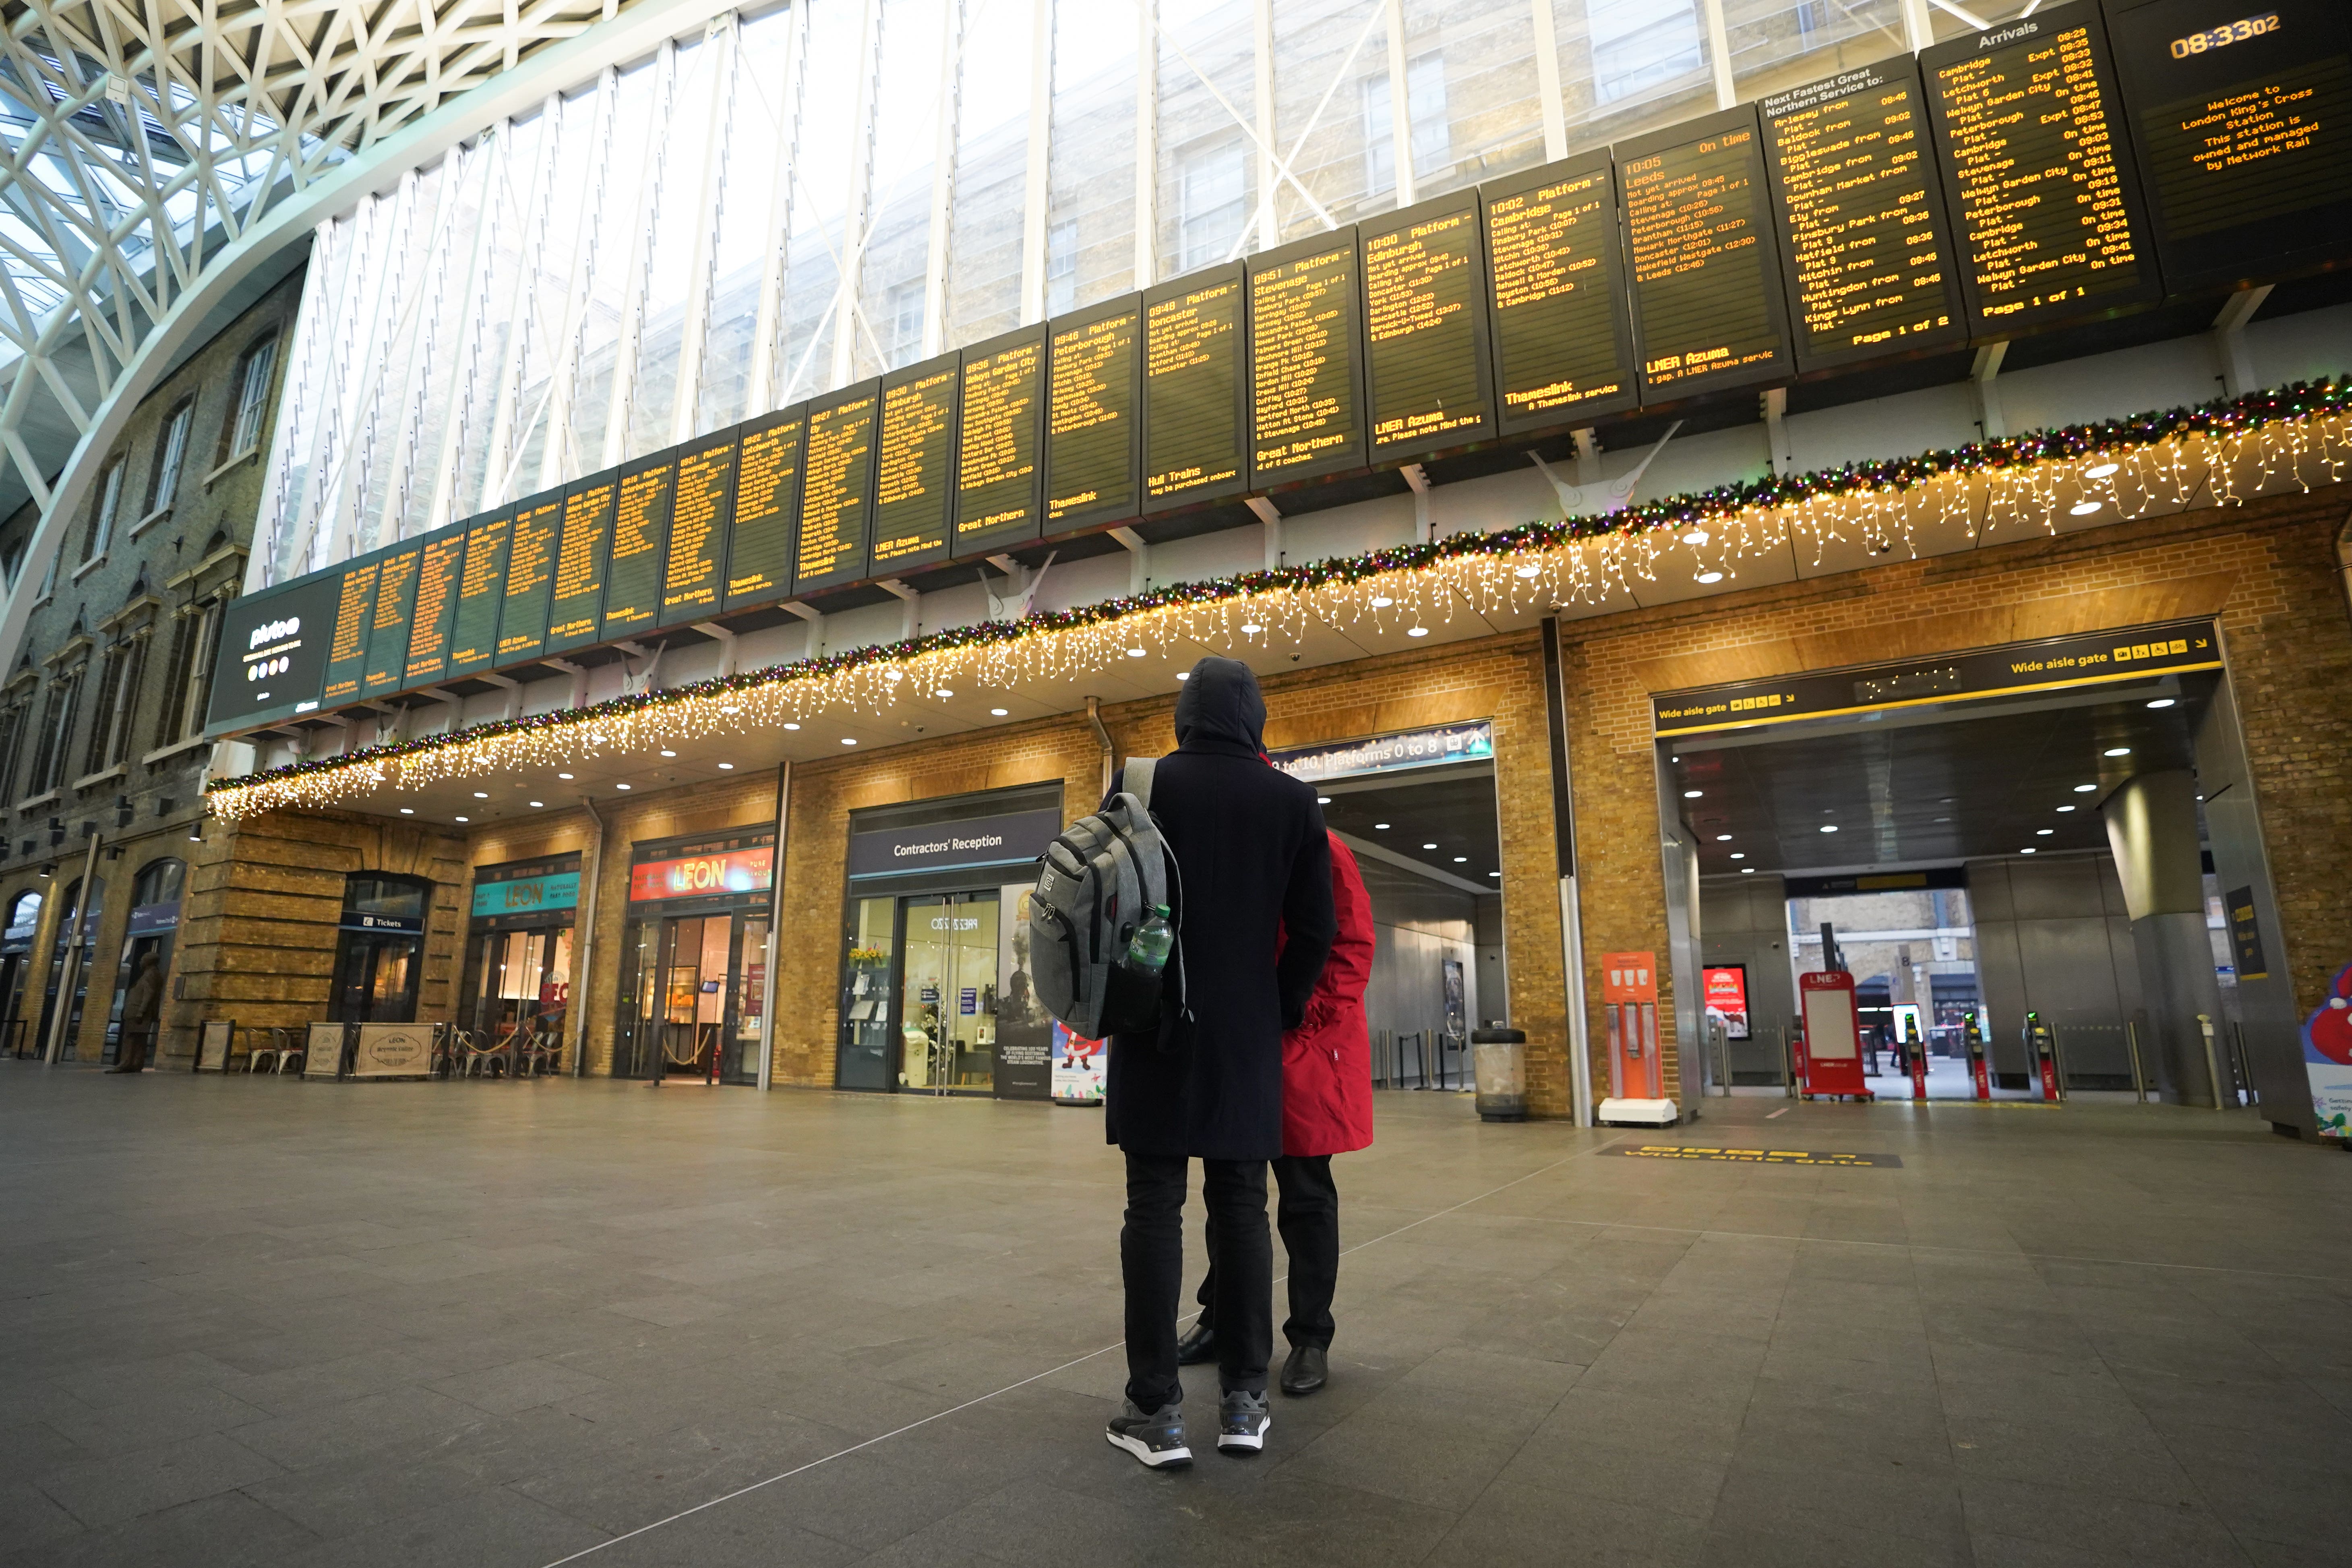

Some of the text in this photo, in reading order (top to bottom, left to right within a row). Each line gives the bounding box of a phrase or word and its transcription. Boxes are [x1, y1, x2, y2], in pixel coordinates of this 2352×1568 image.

[1979, 22, 2038, 48] Arrivals
[1939, 28, 2087, 79] Cambridge 08:29
[1943, 49, 2091, 98] Letchworth 08:33
[1765, 68, 1870, 108] Next Fastest Great
[1767, 76, 1883, 117] Northern Service to:
[1946, 70, 2094, 118] Welwyn Garden City 08:41
[2208, 86, 2280, 112] Welcome to
[1774, 110, 1818, 128] Arlesey
[1950, 90, 2100, 138] Peterborough 08:46
[2182, 88, 2313, 130] London King's Cross
[2205, 115, 2300, 147] This station is
[2226, 112, 2273, 130] Station
[2194, 122, 2319, 162] owned and managed
[1626, 132, 1751, 176] 10:05 On time
[2207, 137, 2310, 172] by Network Rail
[1626, 171, 1665, 190] Leeds
[1491, 178, 1591, 215] 10:02 Platform
[1491, 204, 1551, 228] Cambridge
[1368, 217, 1459, 250] 10:00 Platform
[1792, 215, 1876, 243] Finsbury Park
[1367, 242, 1422, 264] Edinburgh
[1254, 254, 1339, 285] 09:51 Platform
[1255, 274, 1307, 296] Stevenage
[1149, 286, 1227, 317] 09:48 Platform
[1149, 308, 1197, 329] Doncaster
[1054, 318, 1126, 345] 09:46 Platform
[1853, 316, 1949, 345] Page 1 of 2
[1054, 332, 1114, 356] Peterborough
[966, 345, 1032, 374] 09:36 Platform
[1647, 347, 1729, 374] LNER Azuma
[915, 374, 947, 390] Platform
[966, 357, 1036, 385] Welwyn Garden City
[885, 393, 921, 410] Edinburgh
[1506, 382, 1572, 404] Thameslink
[838, 400, 868, 415] Platform
[768, 424, 795, 438] Platform
[810, 426, 820, 434] Ely
[1376, 412, 1444, 434] LNER Azuma
[703, 445, 728, 459] Platform
[742, 438, 778, 456] Letchworth
[1257, 434, 1343, 461] Great Northern
[643, 466, 667, 479] Platform
[680, 461, 709, 476] Stevenage
[1149, 467, 1200, 487] Hull Trains
[587, 485, 609, 498] Platform
[621, 478, 658, 495] Peterborough
[1049, 491, 1096, 509] Thameslink
[958, 509, 1024, 532] Great Northern
[875, 536, 919, 552] LNER Azuma
[799, 555, 836, 571] Thameslink
[730, 573, 763, 588] Thameslink
[665, 587, 712, 605] Great Northern
[606, 607, 635, 620] Thameslink
[2011, 653, 2108, 673] Wide aisle gate
[1659, 703, 1727, 719] Wide aisle gate
[1283, 760, 1297, 772] to
[1302, 755, 1318, 770] 10
[1325, 740, 1437, 766] Platforms 0 to 8
[894, 835, 1002, 856] Contractors' Reception
[750, 860, 766, 868] PURE
[673, 859, 726, 892] LEON
[505, 883, 543, 908] LEON
[376, 918, 401, 927] Tickets
[1810, 973, 1841, 984] LNER
